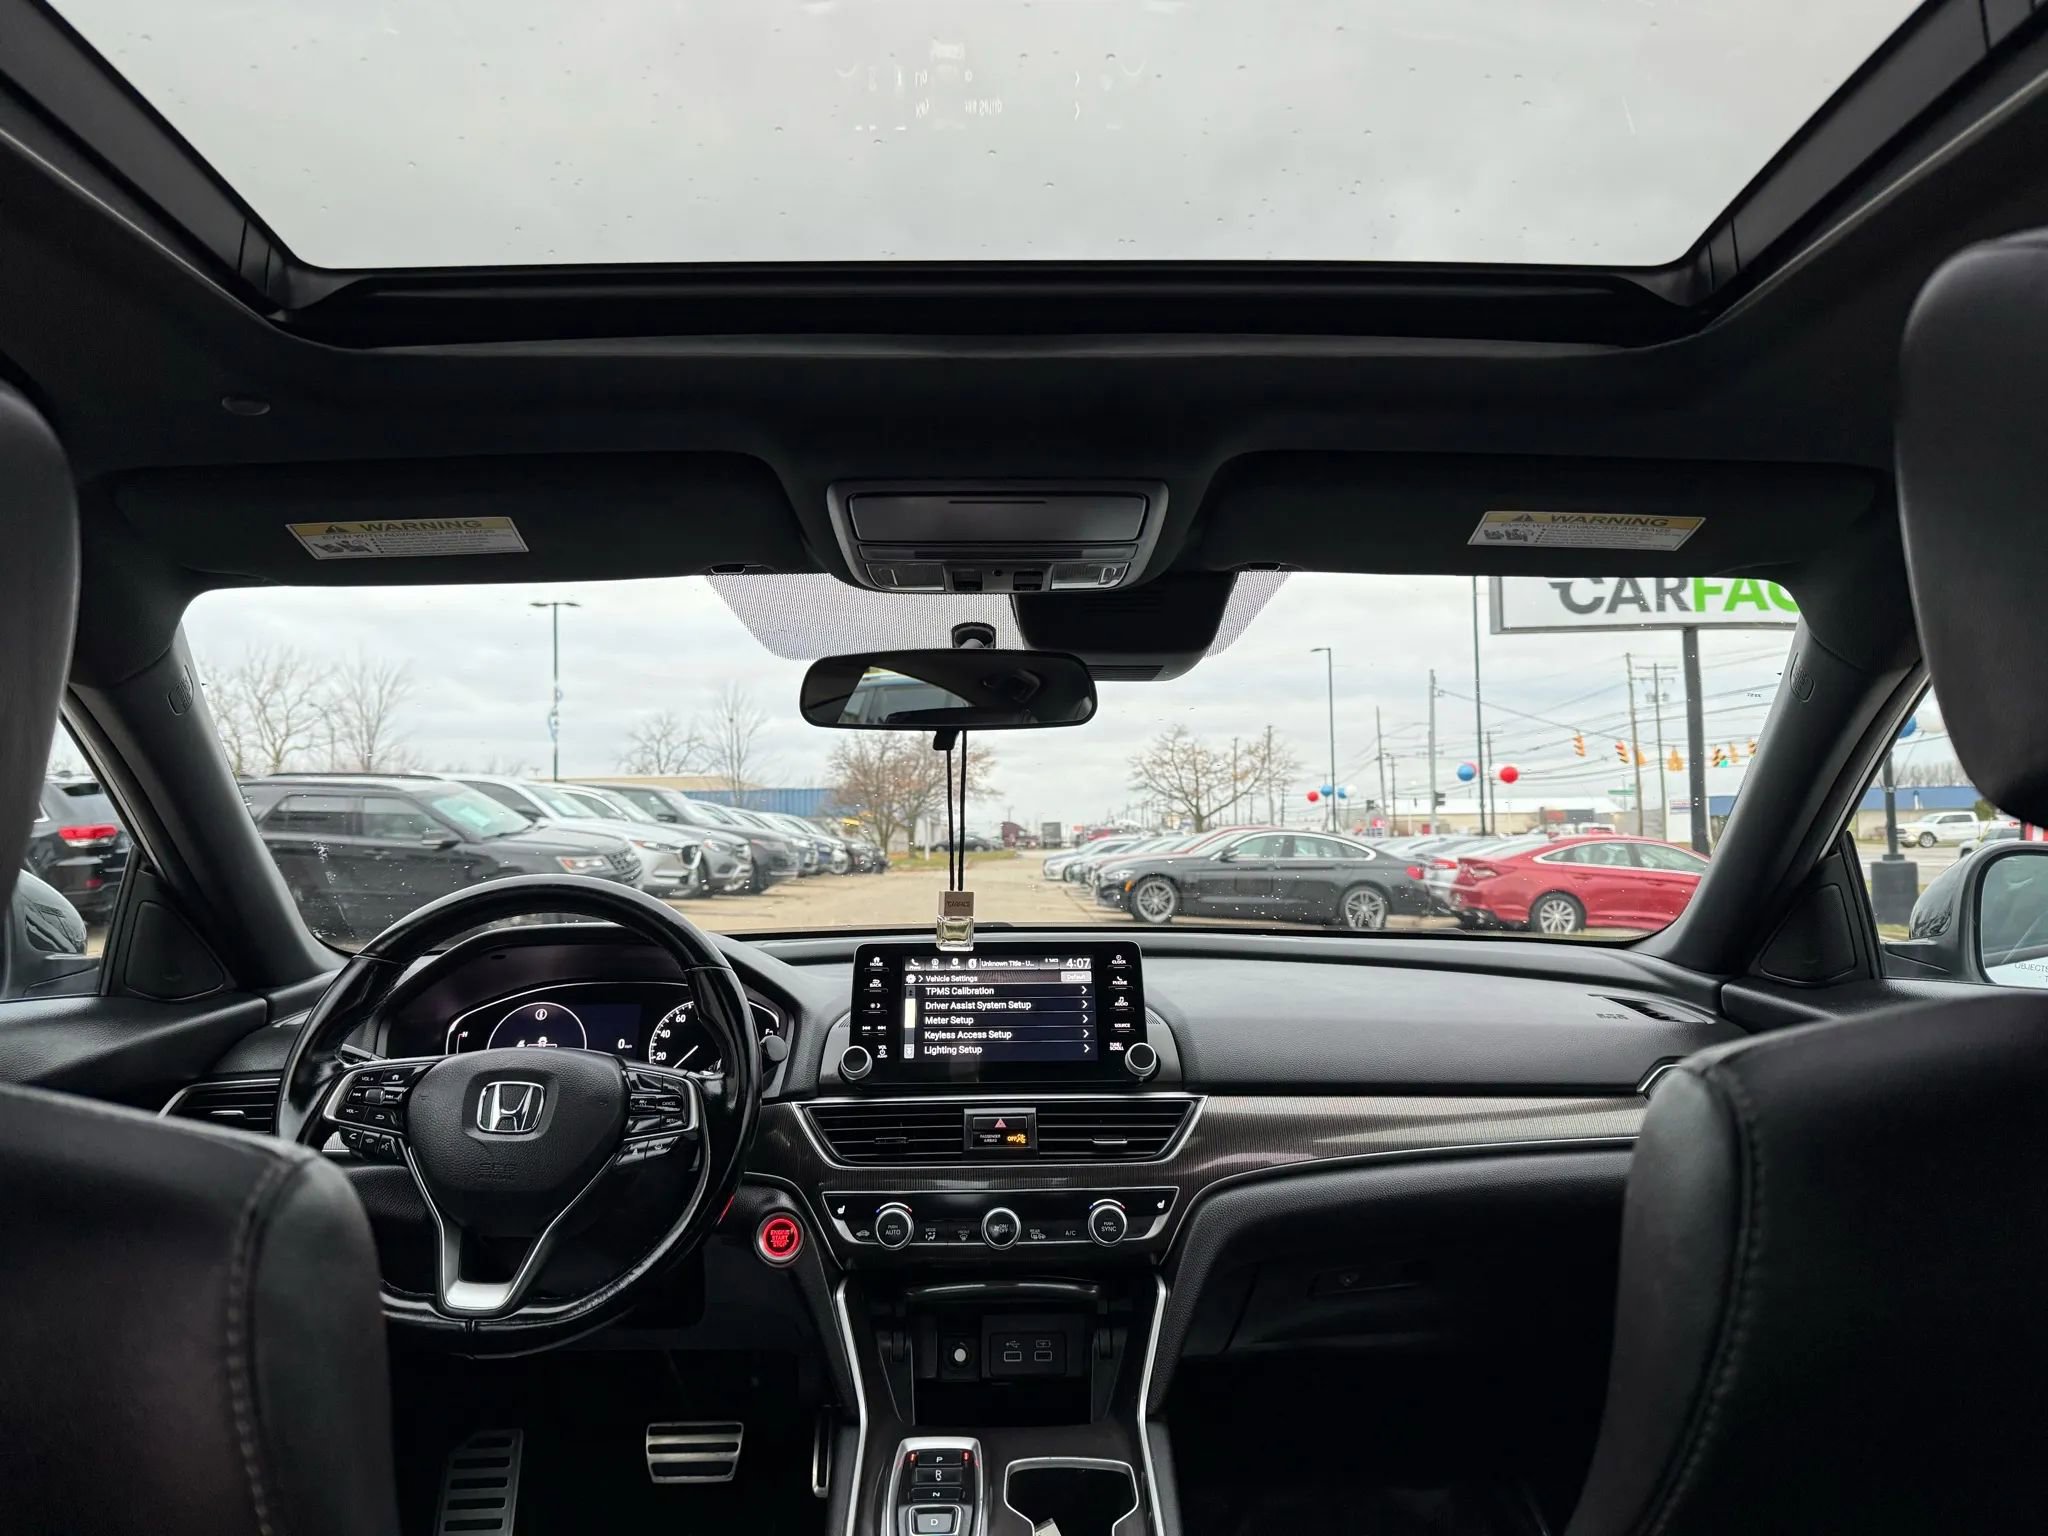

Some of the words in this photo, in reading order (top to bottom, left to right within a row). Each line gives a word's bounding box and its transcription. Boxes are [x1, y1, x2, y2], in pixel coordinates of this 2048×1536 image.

[1550, 514, 1669, 527] WARNING
[359, 520, 482, 532] WARNING
[1066, 958, 1091, 968] 4:07
[951, 975, 978, 983] Settings
[925, 987, 950, 995] TPMS
[951, 987, 995, 995] Calibration
[925, 1001, 949, 1010] Driver
[950, 1001, 976, 1009] Assist
[977, 1001, 1006, 1011] System
[1008, 1001, 1032, 1010] Setup
[675, 1014, 686, 1023] 60
[925, 1016, 949, 1024] Meter
[950, 1016, 974, 1025] Setup
[660, 1029, 671, 1038] 40
[924, 1031, 955, 1041] Keyless
[957, 1031, 987, 1039] Access
[988, 1030, 1012, 1040] Setup
[617, 1038, 625, 1049] 0
[924, 1046, 957, 1055] Lighting
[958, 1045, 983, 1055] Setup
[656, 1052, 667, 1060] 20
[935, 1469, 942, 1478] R
[930, 1518, 938, 1526] D
